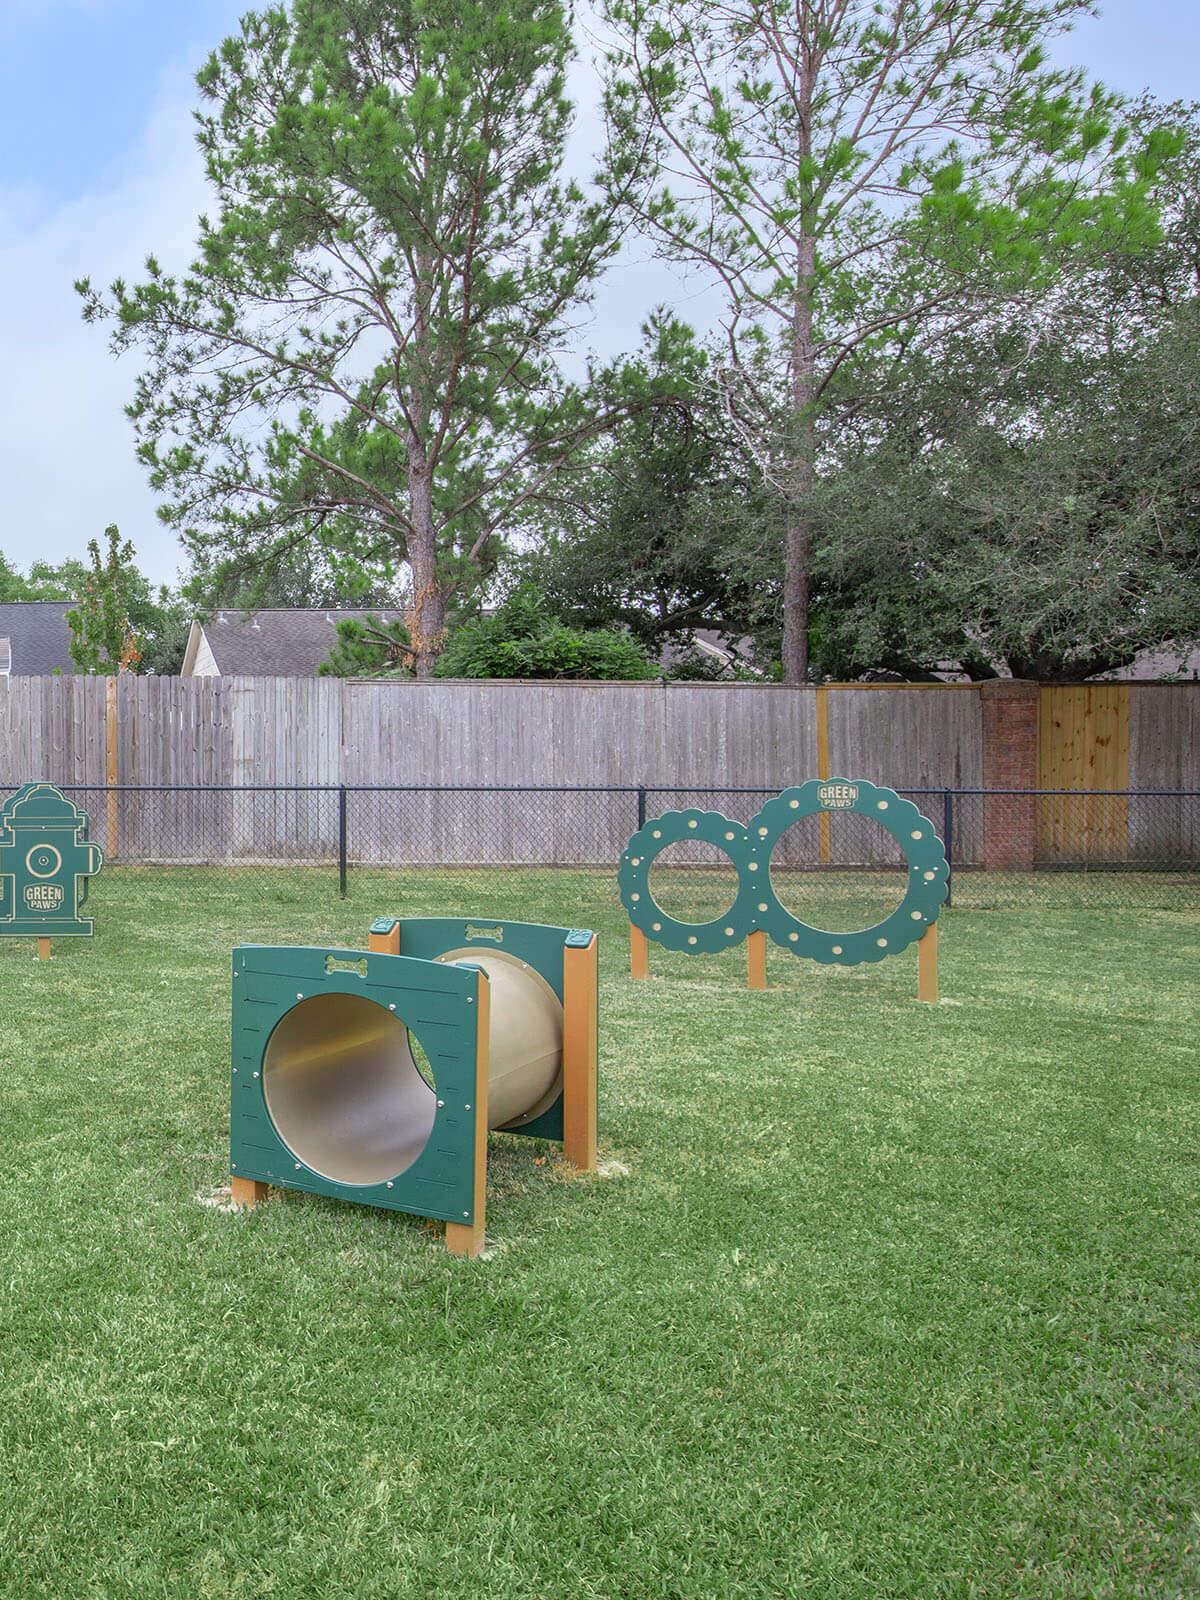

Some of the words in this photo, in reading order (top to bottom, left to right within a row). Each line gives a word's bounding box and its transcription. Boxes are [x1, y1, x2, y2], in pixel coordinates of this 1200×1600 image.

[820, 785, 856, 799] GREEN
[824, 799, 851, 807] PAWS
[26, 886, 62, 900] GREEN
[31, 900, 57, 909] PAWS
